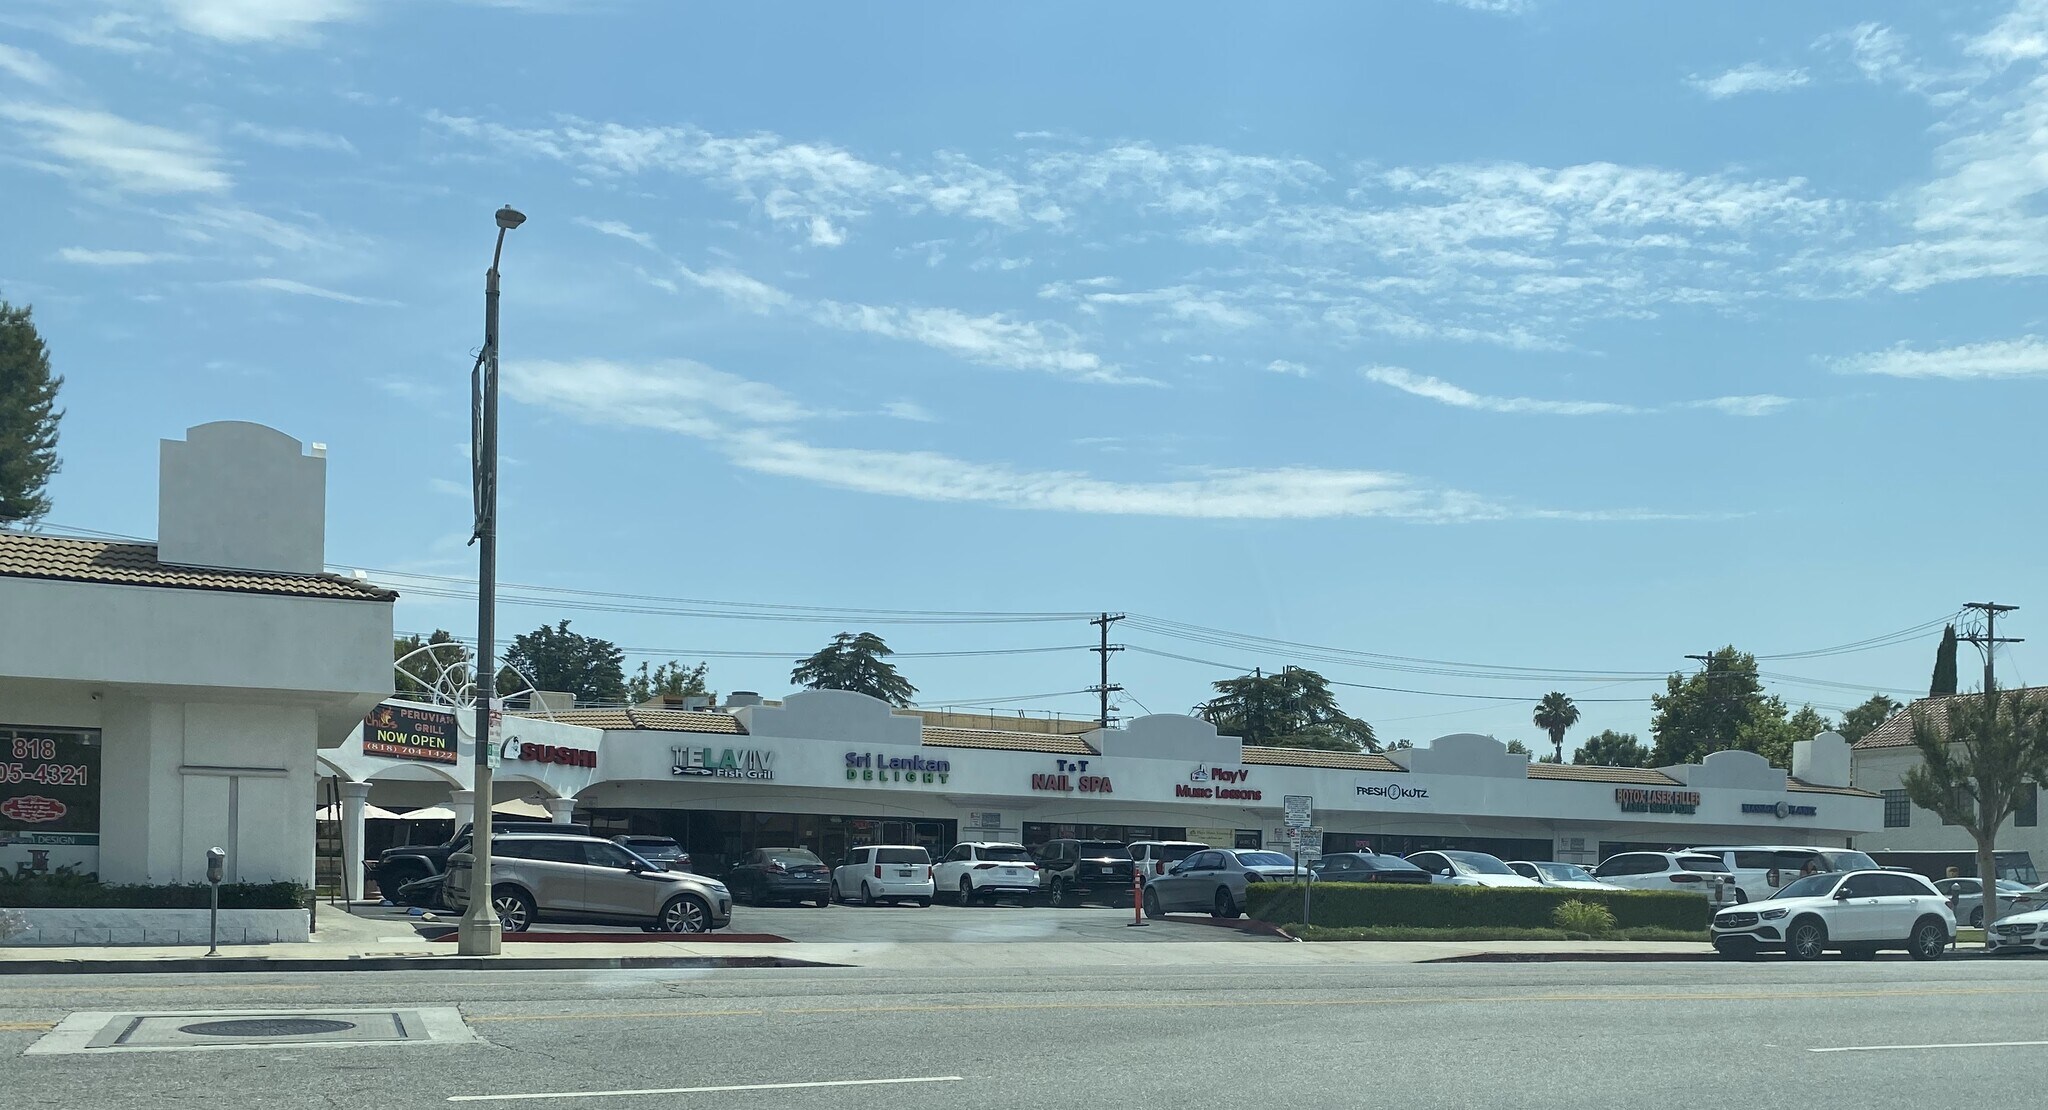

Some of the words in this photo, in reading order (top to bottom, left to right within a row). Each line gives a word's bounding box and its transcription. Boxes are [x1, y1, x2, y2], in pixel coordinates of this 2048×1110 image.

[400, 708, 454, 724] PERUVIAN
[414, 723, 445, 735] GRILL
[377, 729, 408, 744] NOW
[411, 734, 446, 749] OPEN
[12, 737, 56, 760] 818
[367, 742, 397, 753] (818)
[401, 746, 453, 759] 704-1422
[519, 742, 597, 769] SUSHI
[845, 751, 872, 769] Sri
[877, 754, 951, 772] Lankan
[716, 768, 743, 778] Fish
[747, 769, 775, 780] Grill
[846, 768, 950, 785] DELIGHT
[1032, 773, 1074, 792] NAIL
[1079, 775, 1113, 793] SPA
[1175, 784, 1213, 799] Music
[1215, 785, 1262, 801] Lessons
[1356, 786, 1387, 798] FRESH
[1402, 787, 1430, 799] KUTZ
[1615, 788, 1644, 803] BOTOX
[1673, 791, 1701, 806] FILLER
[38, 835, 76, 845] DESIGN
